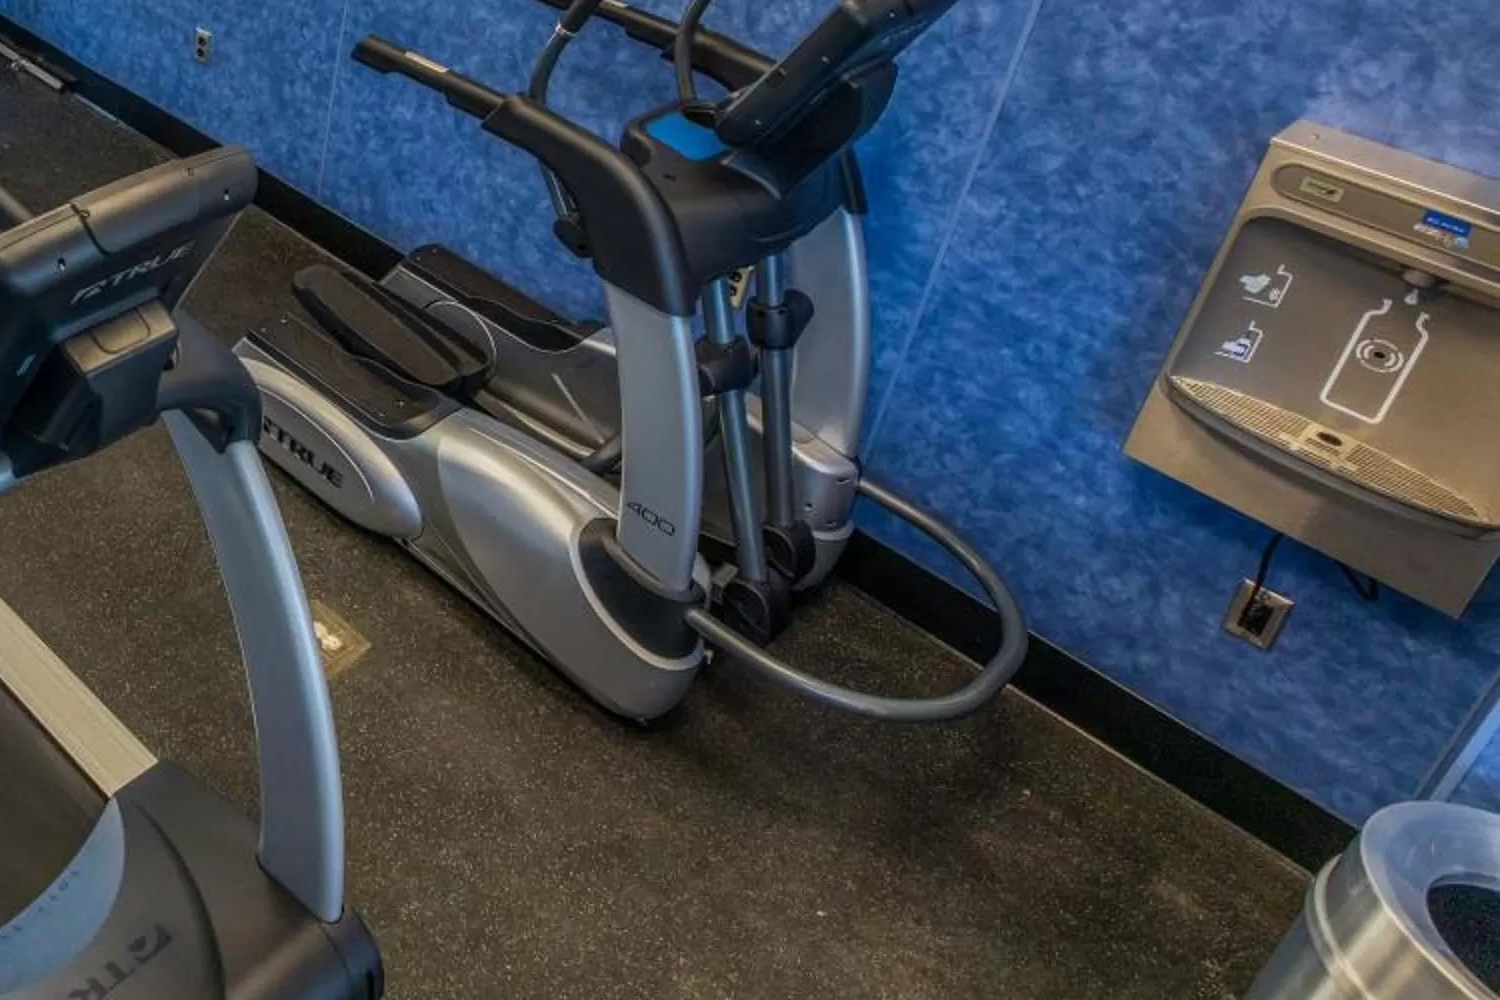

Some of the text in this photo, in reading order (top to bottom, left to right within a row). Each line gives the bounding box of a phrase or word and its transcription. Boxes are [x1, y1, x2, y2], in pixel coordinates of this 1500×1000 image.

[110, 240, 197, 287] TRUE
[271, 420, 344, 489] TRUE
[627, 501, 675, 537] 400
